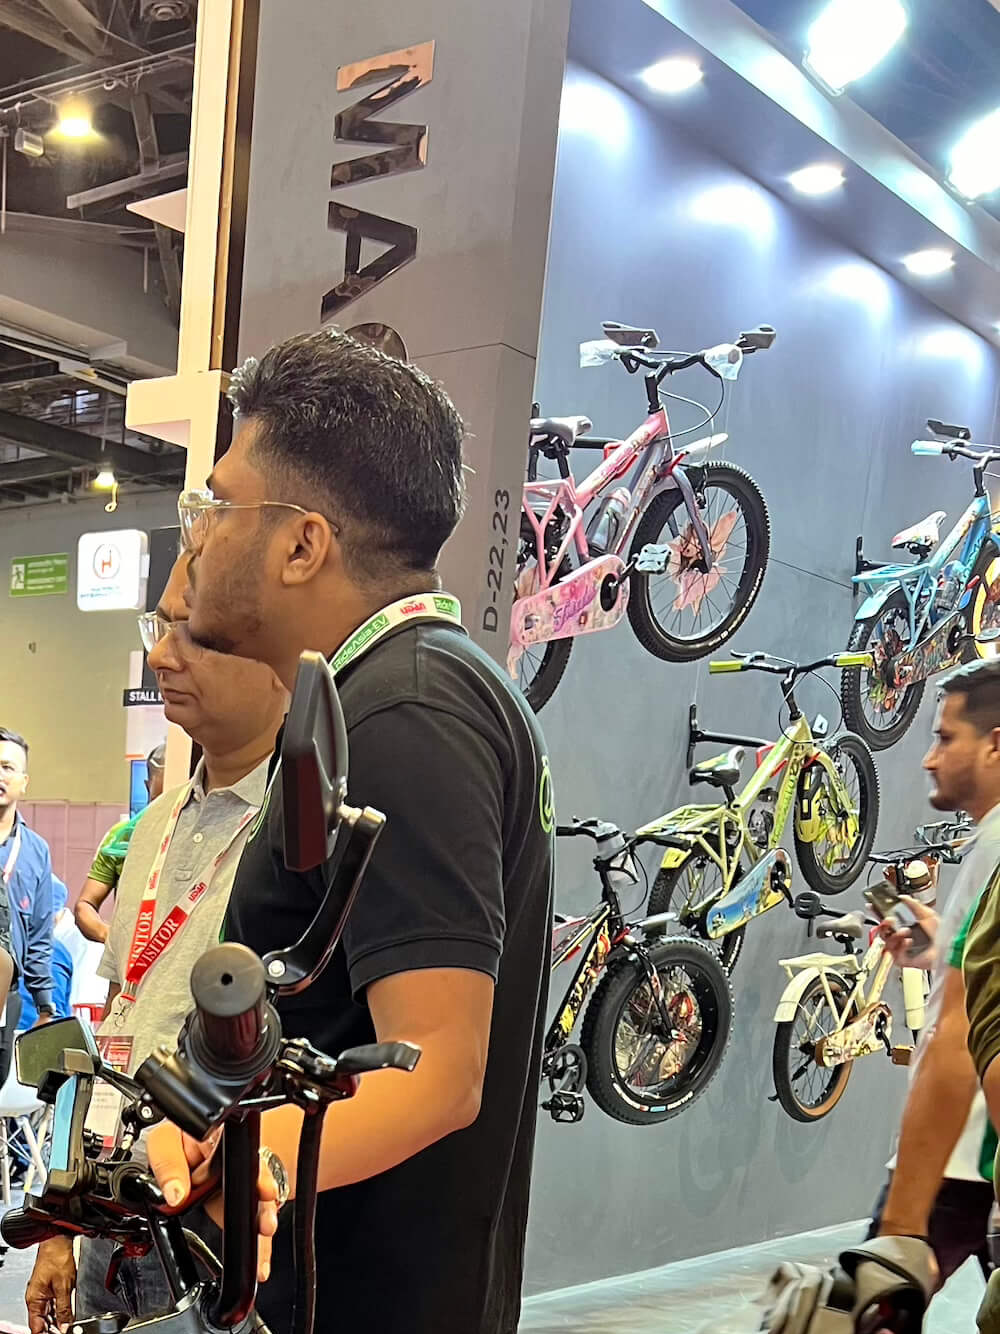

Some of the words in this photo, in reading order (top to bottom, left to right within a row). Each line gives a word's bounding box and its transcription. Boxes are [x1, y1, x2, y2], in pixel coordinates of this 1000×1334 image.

[482, 488, 510, 633] D-22,23
[129, 690, 157, 702] STALL
[129, 911, 153, 968] ISITOR
[135, 918, 180, 968] VISITOR
